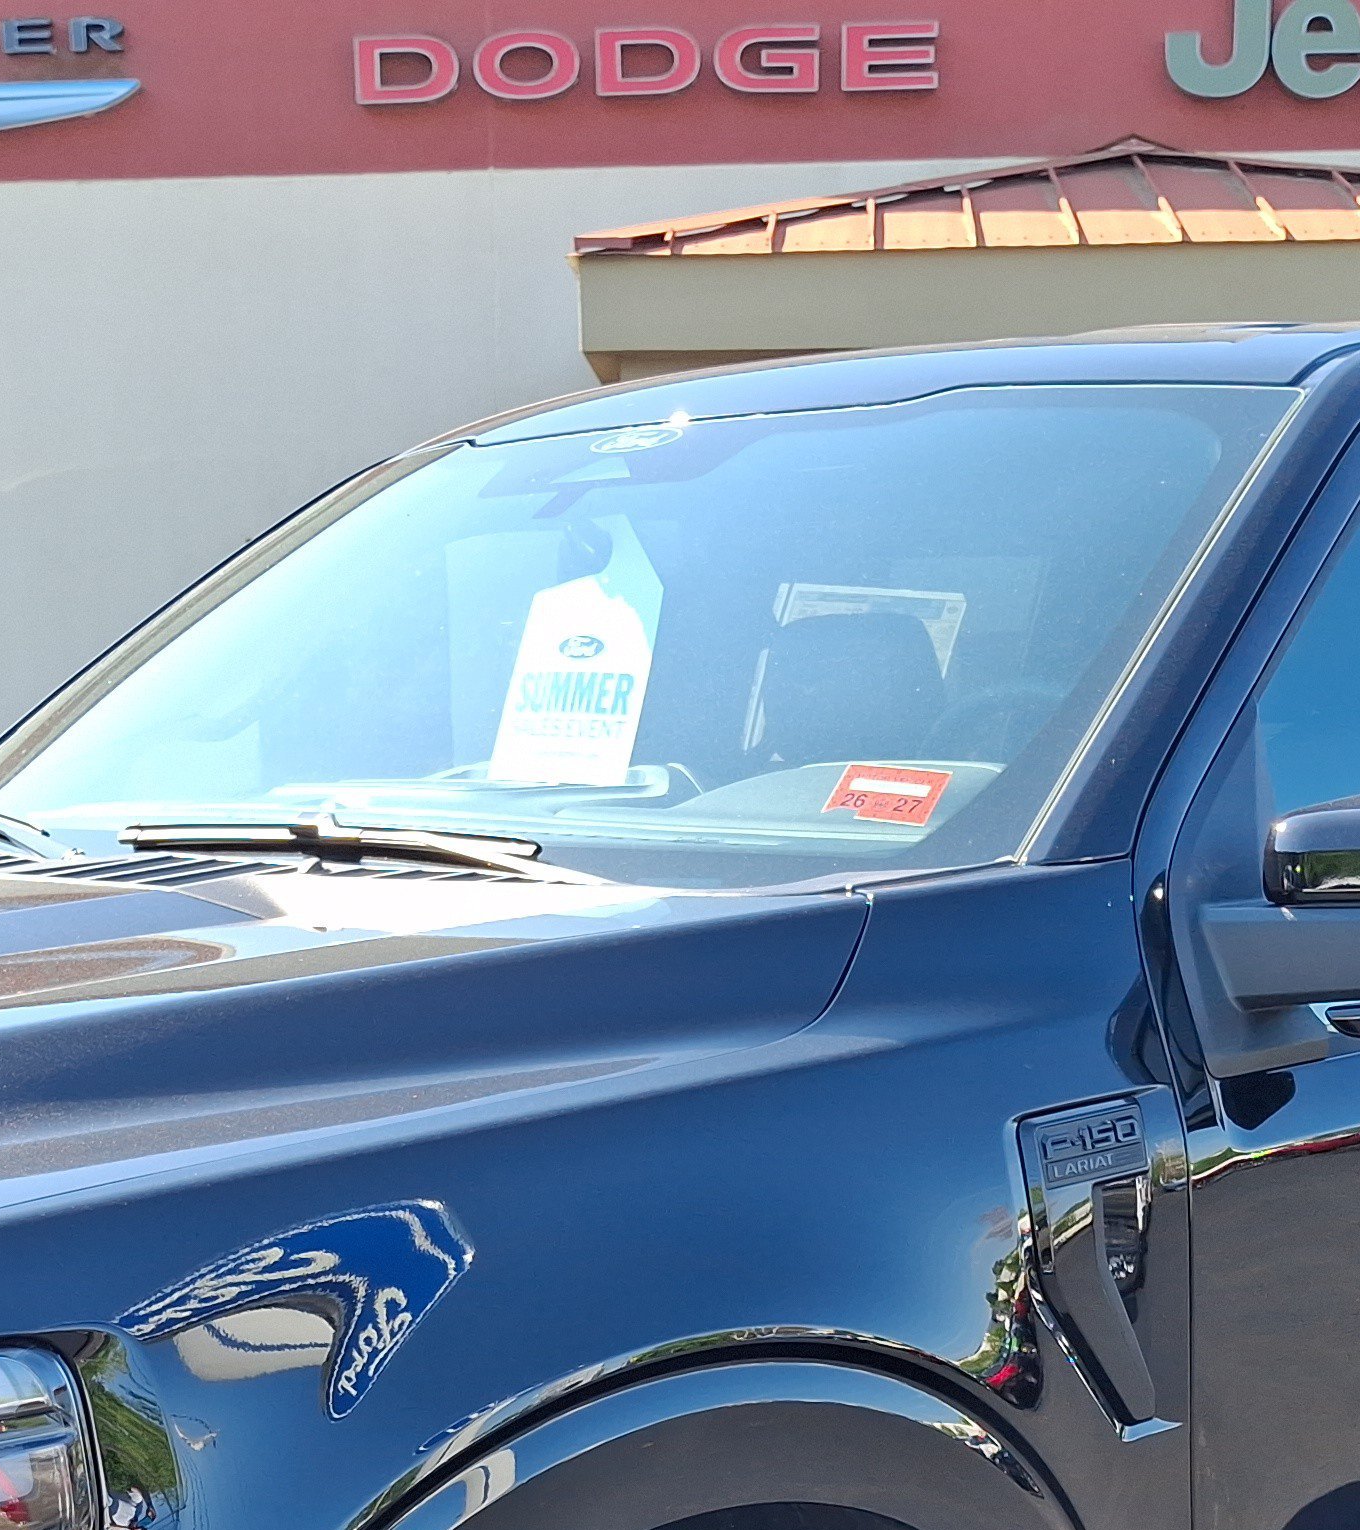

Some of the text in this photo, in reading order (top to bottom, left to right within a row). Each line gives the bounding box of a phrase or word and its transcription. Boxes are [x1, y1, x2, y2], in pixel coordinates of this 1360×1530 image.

[352, 21, 939, 105] DODGE
[515, 671, 635, 716] SUMMER
[840, 793, 868, 809] 26
[892, 797, 924, 814] 27
[1041, 1115, 1140, 1160] F-150
[1053, 1153, 1115, 1179] LARIAT
